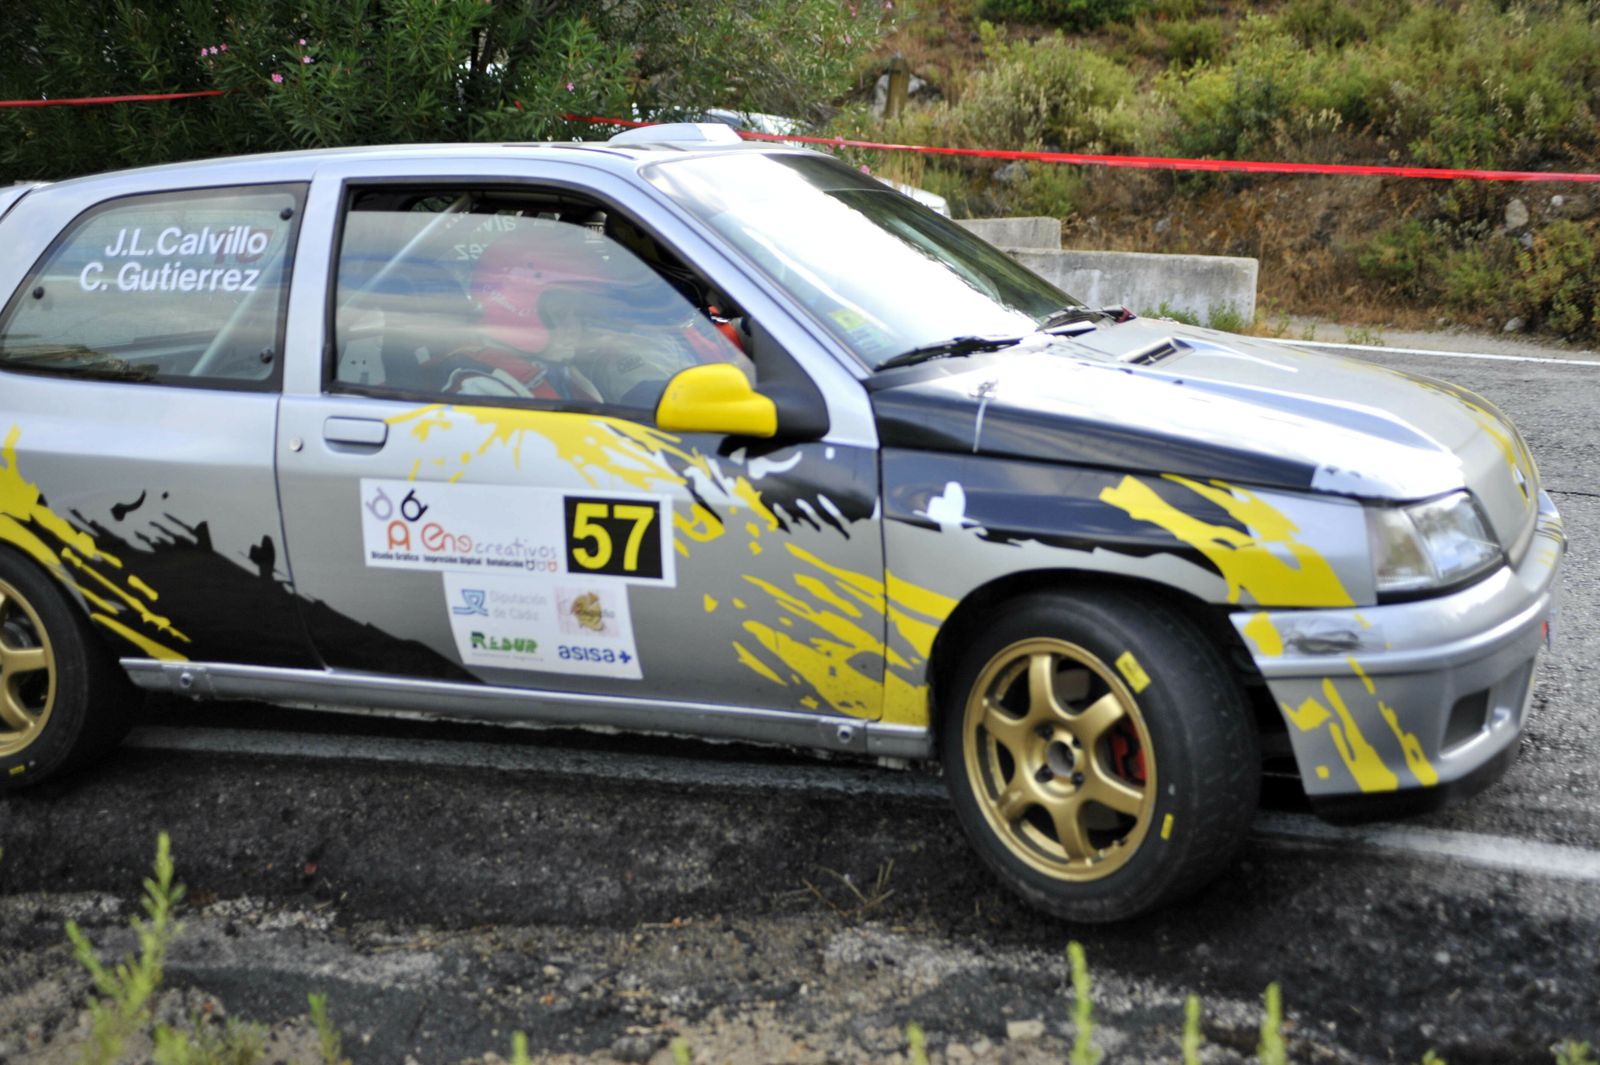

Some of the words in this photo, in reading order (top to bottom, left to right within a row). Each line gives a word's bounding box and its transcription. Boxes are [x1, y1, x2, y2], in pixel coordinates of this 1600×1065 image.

[105, 225, 269, 257] J.L.Calvillo
[80, 262, 108, 291] C.
[117, 261, 260, 292] Gutierrez
[571, 502, 655, 572] 57
